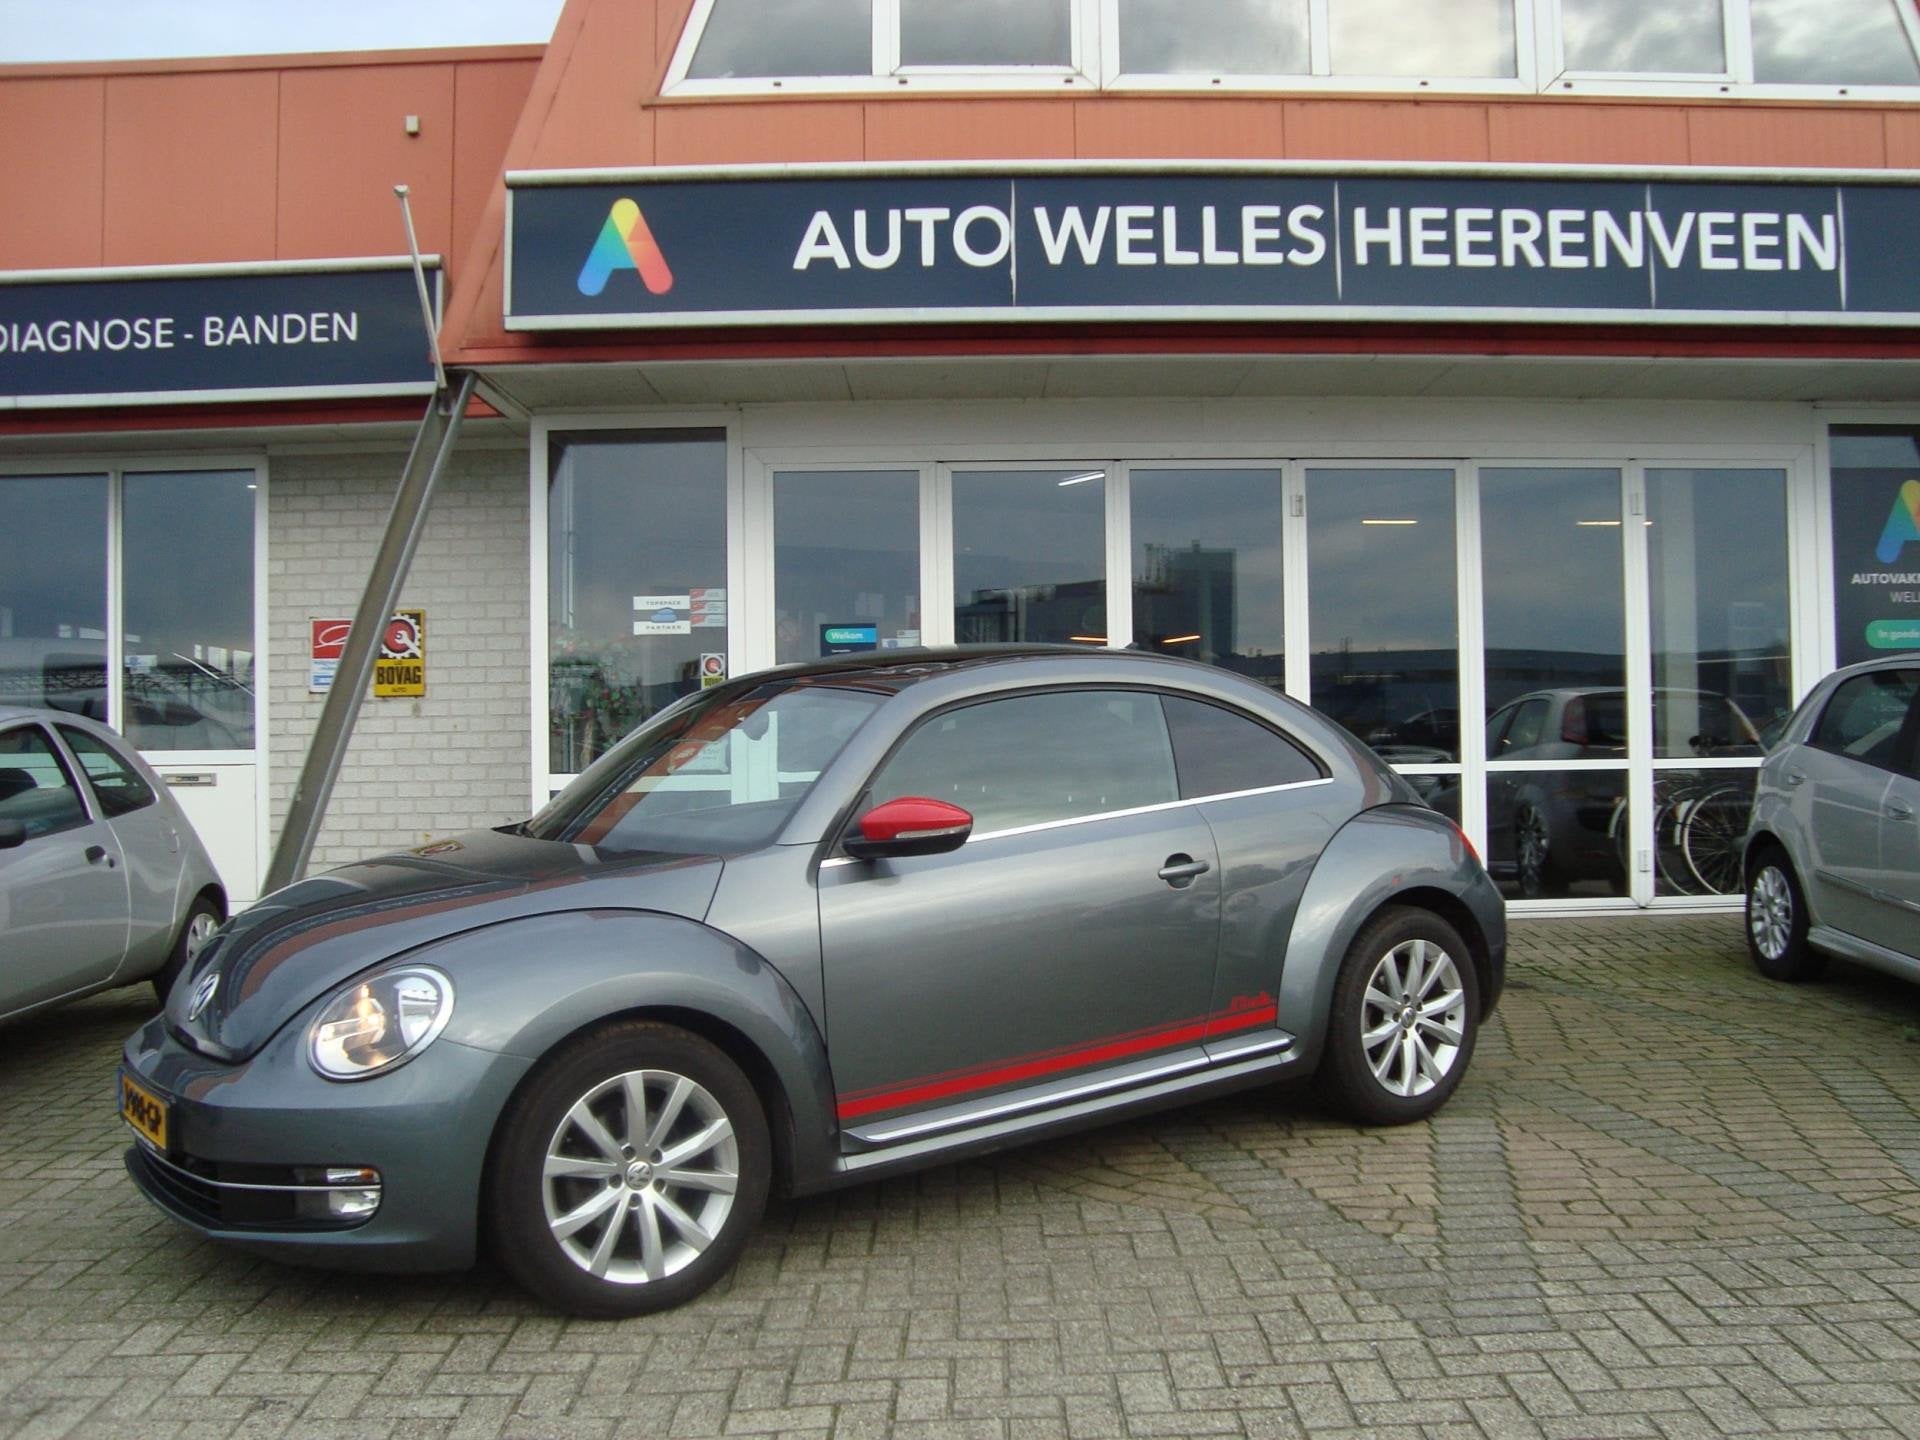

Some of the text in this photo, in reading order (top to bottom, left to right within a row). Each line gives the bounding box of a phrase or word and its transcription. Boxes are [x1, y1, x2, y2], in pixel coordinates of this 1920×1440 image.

[793, 204, 1836, 271] AUTO WELLES HEERENVEEN
[204, 311, 358, 347] BANDEN
[1851, 573, 1920, 585] AUTOVAK
[377, 666, 422, 685] BOVAG
